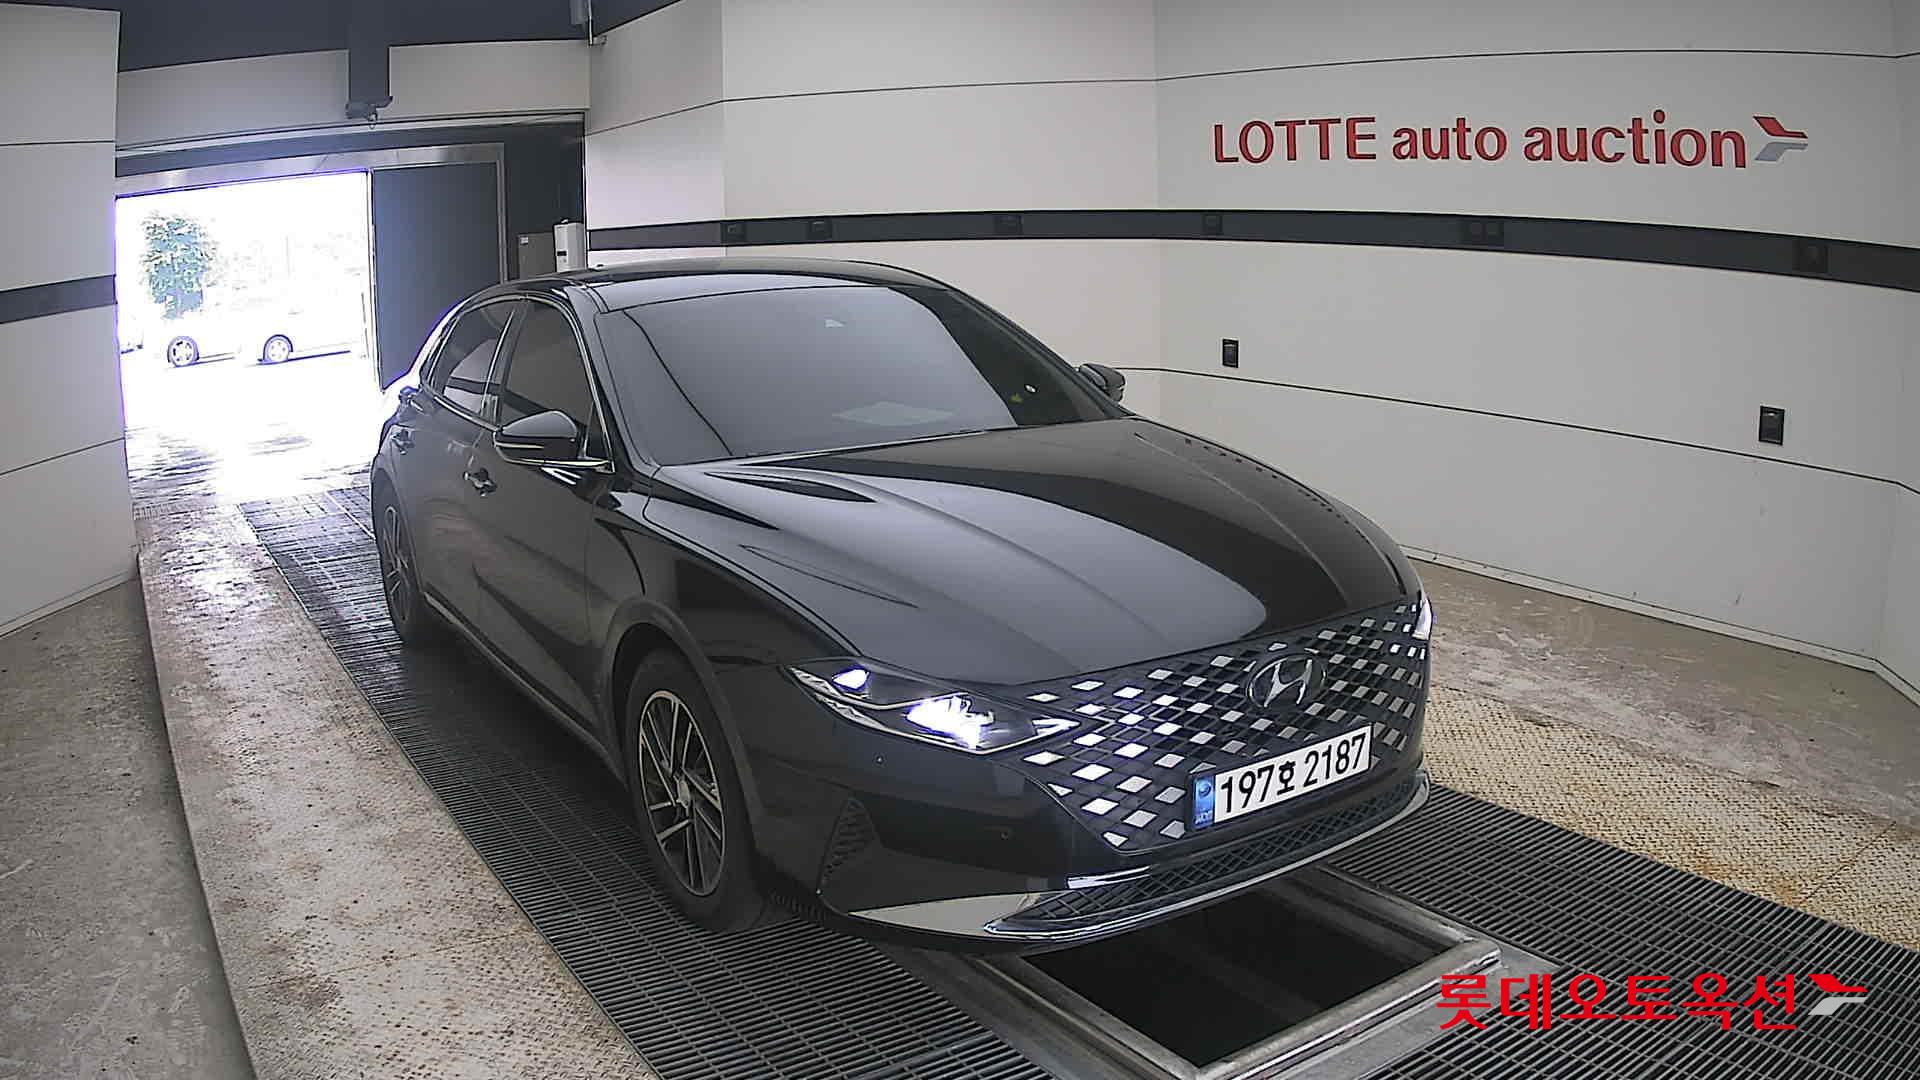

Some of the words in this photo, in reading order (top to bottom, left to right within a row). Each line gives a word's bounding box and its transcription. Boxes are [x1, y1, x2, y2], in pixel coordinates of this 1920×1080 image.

[1213, 116, 1377, 163] LOTTE
[1392, 117, 1507, 161] auto
[1523, 109, 1747, 169] auction
[1220, 760, 1296, 813] 197호
[1303, 732, 1366, 787] 2187
